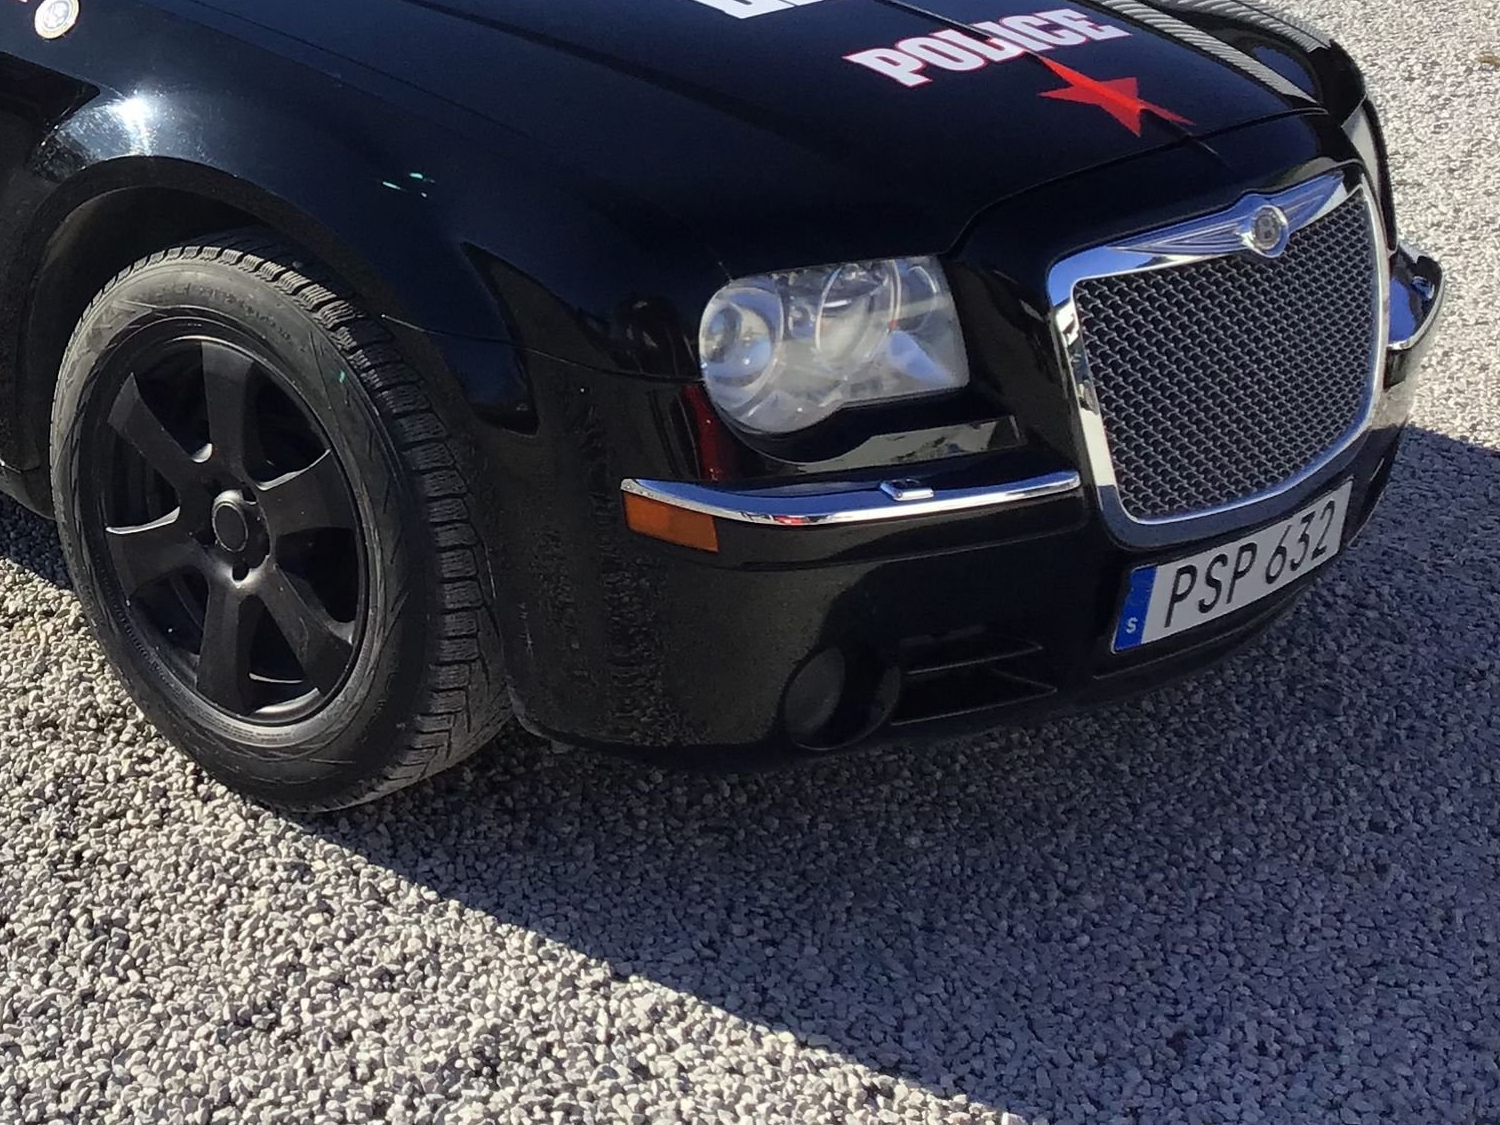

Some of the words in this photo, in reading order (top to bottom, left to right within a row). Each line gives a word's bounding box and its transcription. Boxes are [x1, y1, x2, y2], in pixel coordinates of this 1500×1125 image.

[842, 7, 1133, 87] POLICE
[1164, 542, 1258, 628] PSP
[1265, 499, 1335, 585] 632
[1125, 616, 1138, 634] S
